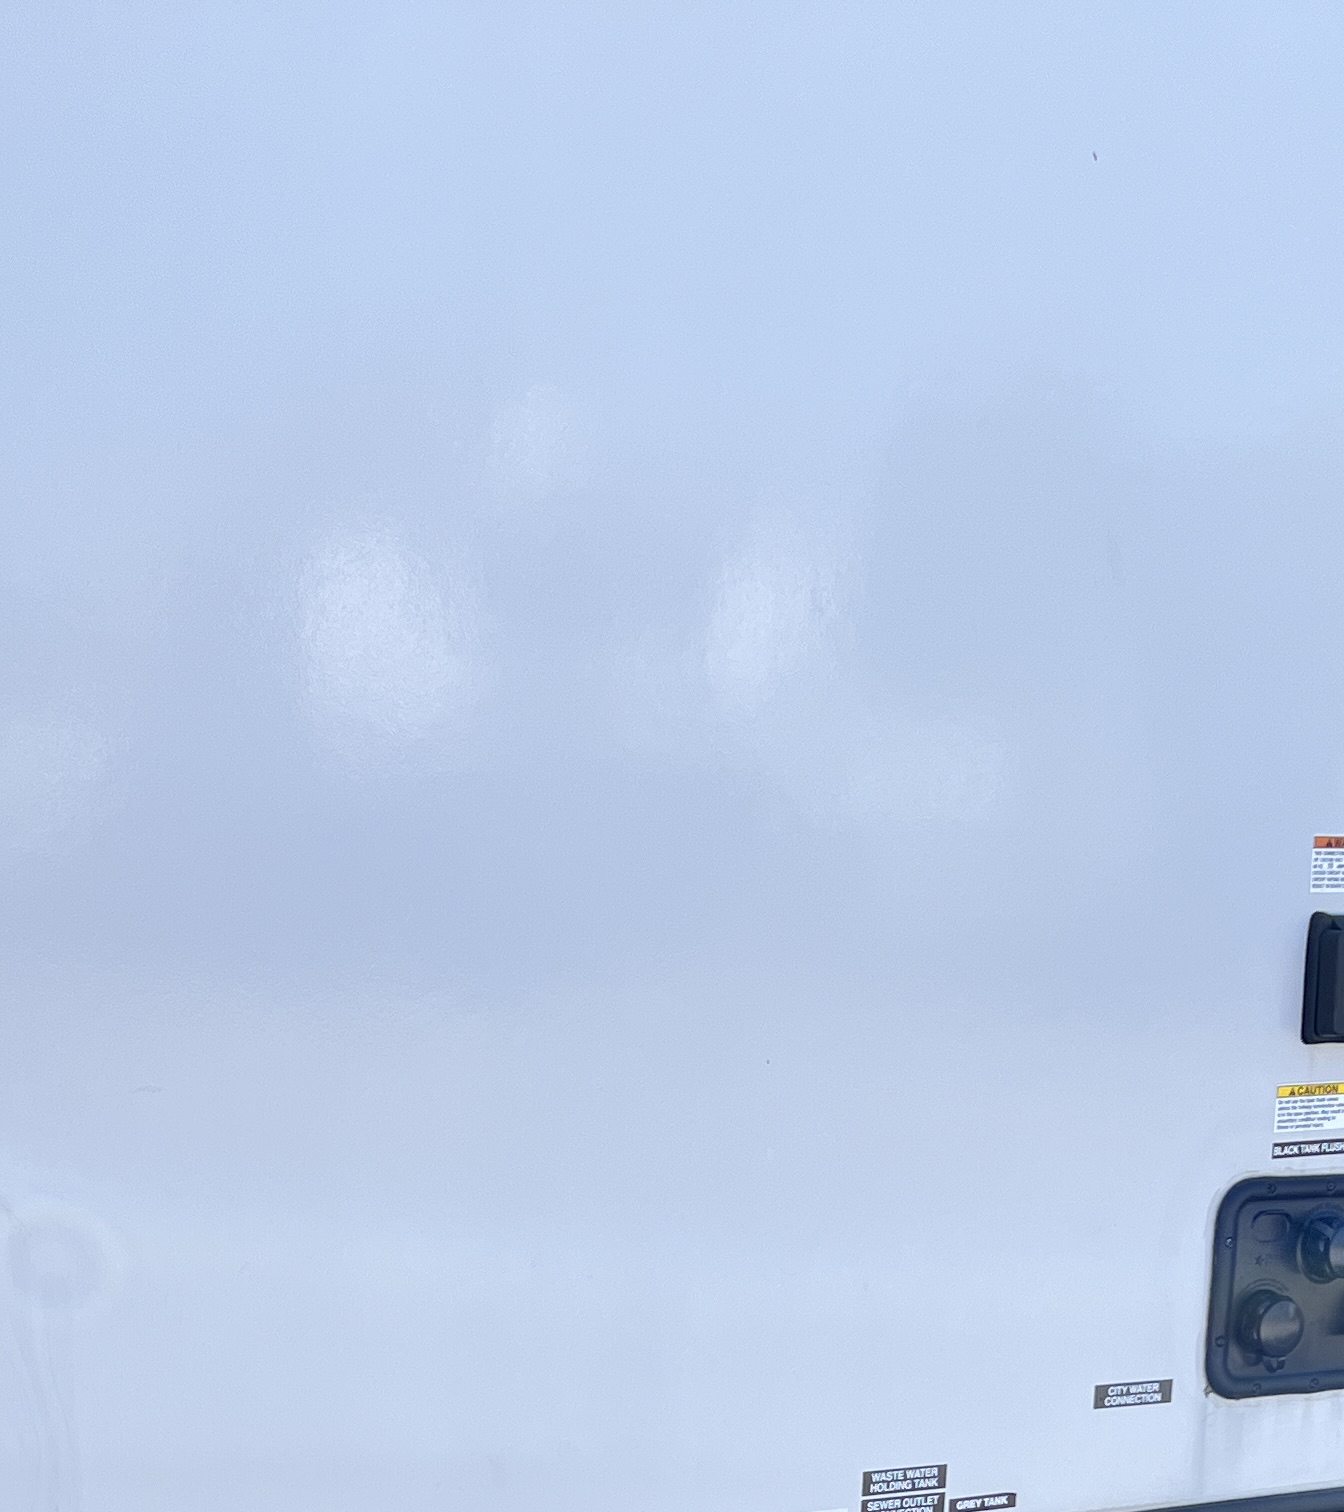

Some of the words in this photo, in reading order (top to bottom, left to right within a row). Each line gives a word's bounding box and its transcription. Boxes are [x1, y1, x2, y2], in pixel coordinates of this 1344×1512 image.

[1297, 1085, 1338, 1096] CAUTION
[1273, 1144, 1299, 1156] BLACK
[1301, 1143, 1320, 1154] TANK
[1108, 1384, 1129, 1396] CITY
[1129, 1382, 1160, 1394] WATER
[1104, 1393, 1162, 1407] CONNECTION
[871, 1470, 904, 1482] WASTE
[905, 1467, 938, 1479] WATER
[869, 1480, 912, 1493] HOLDING
[914, 1477, 938, 1489] TANK
[867, 1500, 901, 1512] SEWER
[902, 1495, 940, 1508] OUTLET
[956, 1498, 982, 1511] GREY
[983, 1494, 1009, 1507] TANK
